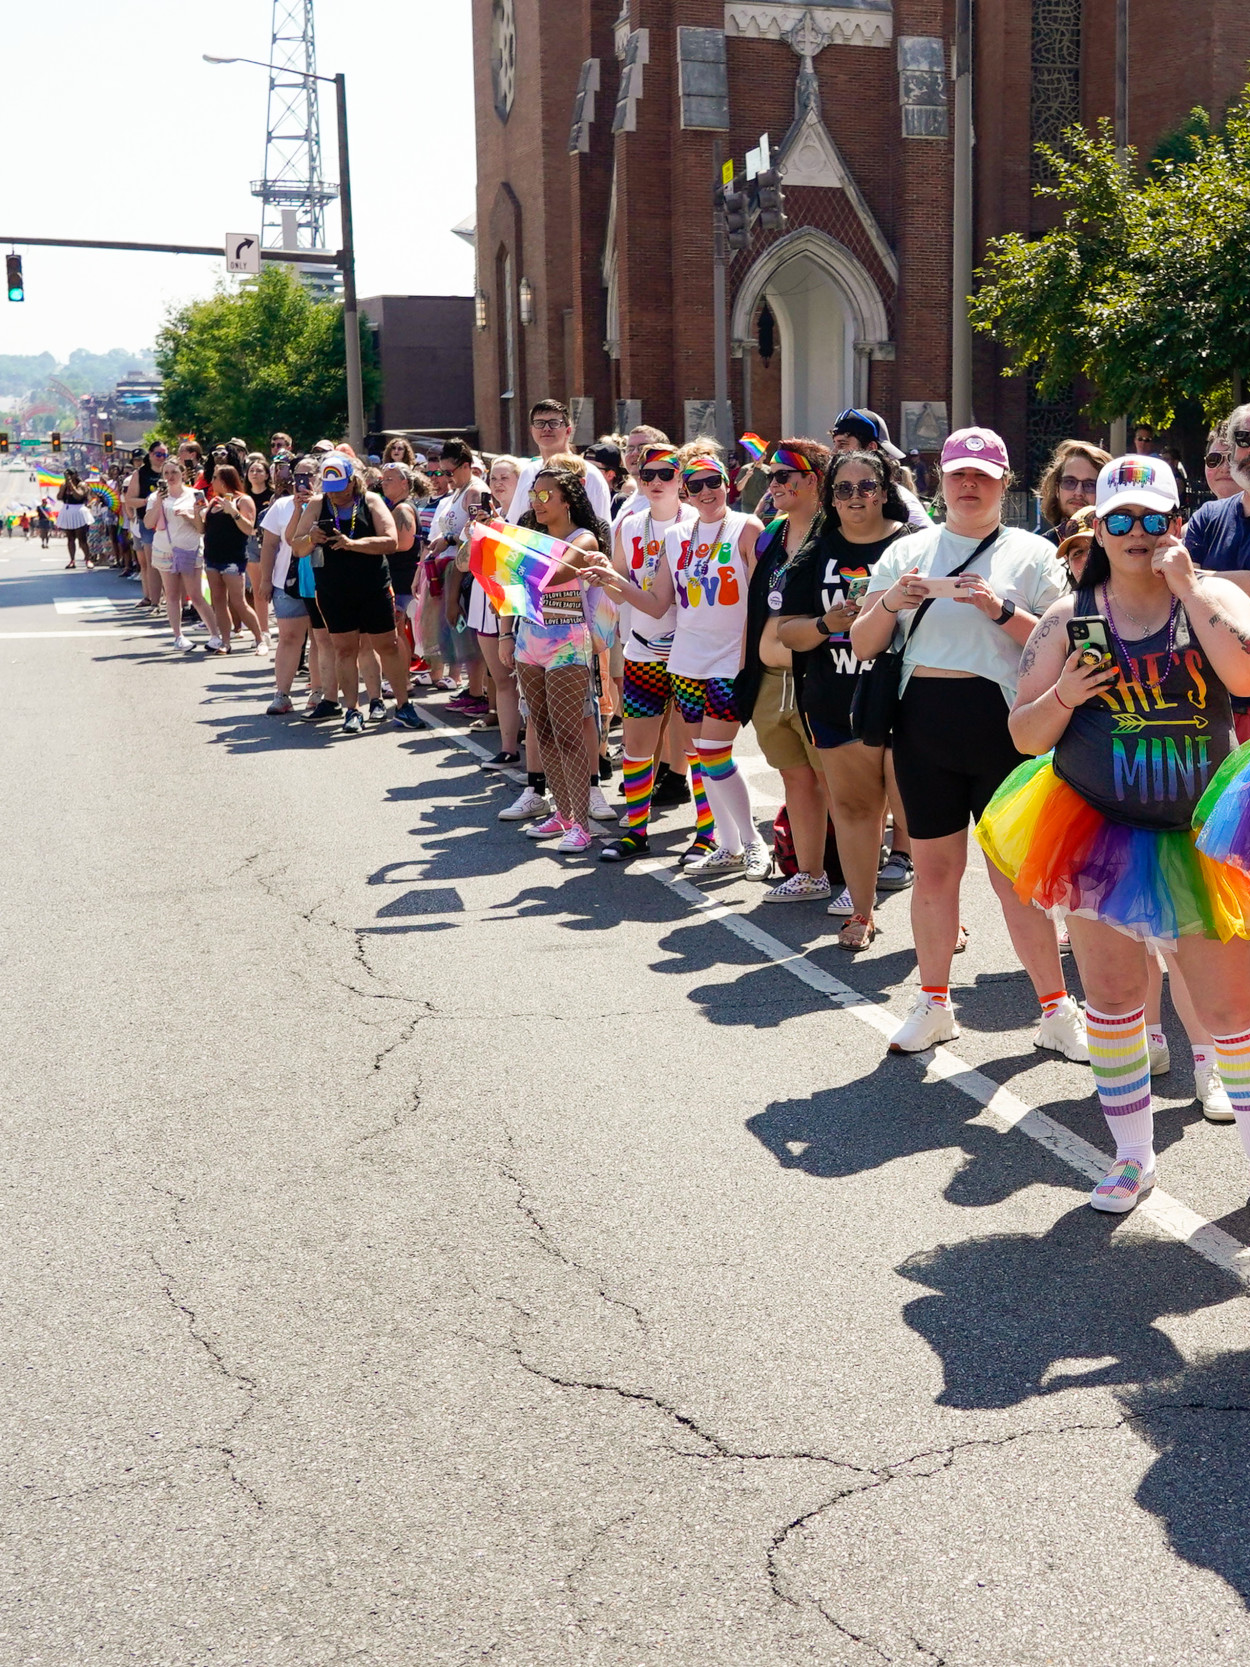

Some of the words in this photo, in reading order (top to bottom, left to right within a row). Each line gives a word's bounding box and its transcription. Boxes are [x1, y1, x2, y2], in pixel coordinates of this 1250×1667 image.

[230, 261, 247, 270] ONLY
[631, 536, 665, 569] Lo
[674, 565, 740, 610] LOVE
[1099, 649, 1207, 713] HE'S
[1111, 734, 1213, 804] MINE
